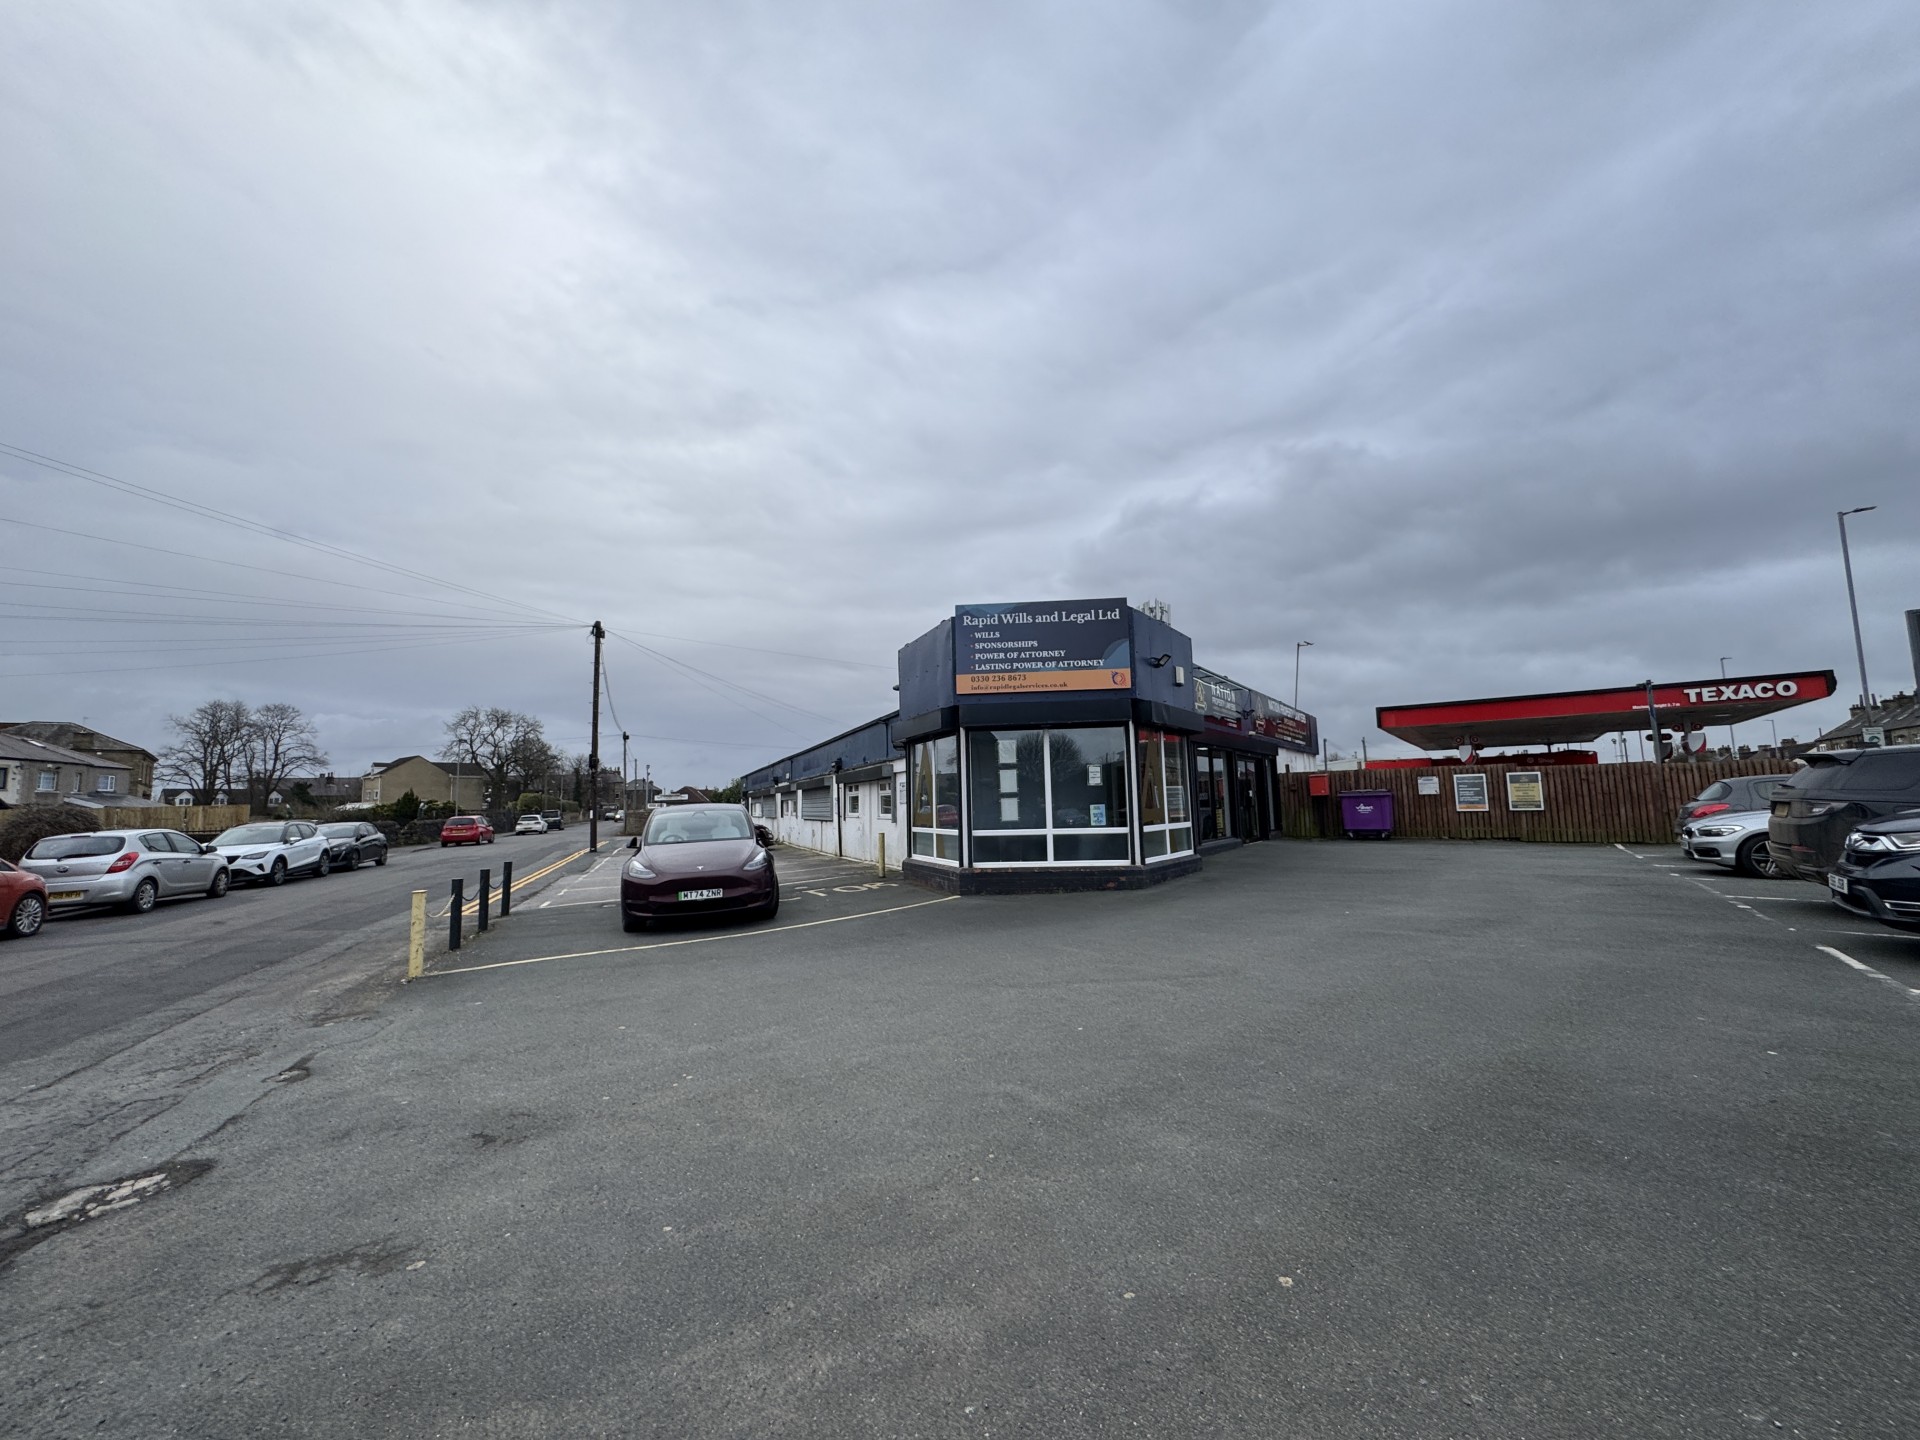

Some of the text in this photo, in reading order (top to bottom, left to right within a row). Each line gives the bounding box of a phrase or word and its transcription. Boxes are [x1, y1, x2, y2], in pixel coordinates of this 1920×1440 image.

[963, 608, 1120, 628] Rapid Wills and Legal Ltd
[975, 631, 1000, 639] WILLS
[975, 640, 1038, 649] SPONSORSHIPS
[975, 650, 1066, 660] POWER OF ATTORNEY
[975, 662, 1011, 671] LASTING
[1013, 661, 1043, 669] POWER
[1058, 659, 1105, 668] ATTORNEY
[970, 675, 990, 683] 0330
[970, 682, 1068, 691] info@rapidlegalservices.co.uk
[1684, 680, 1798, 703] TEXACO
